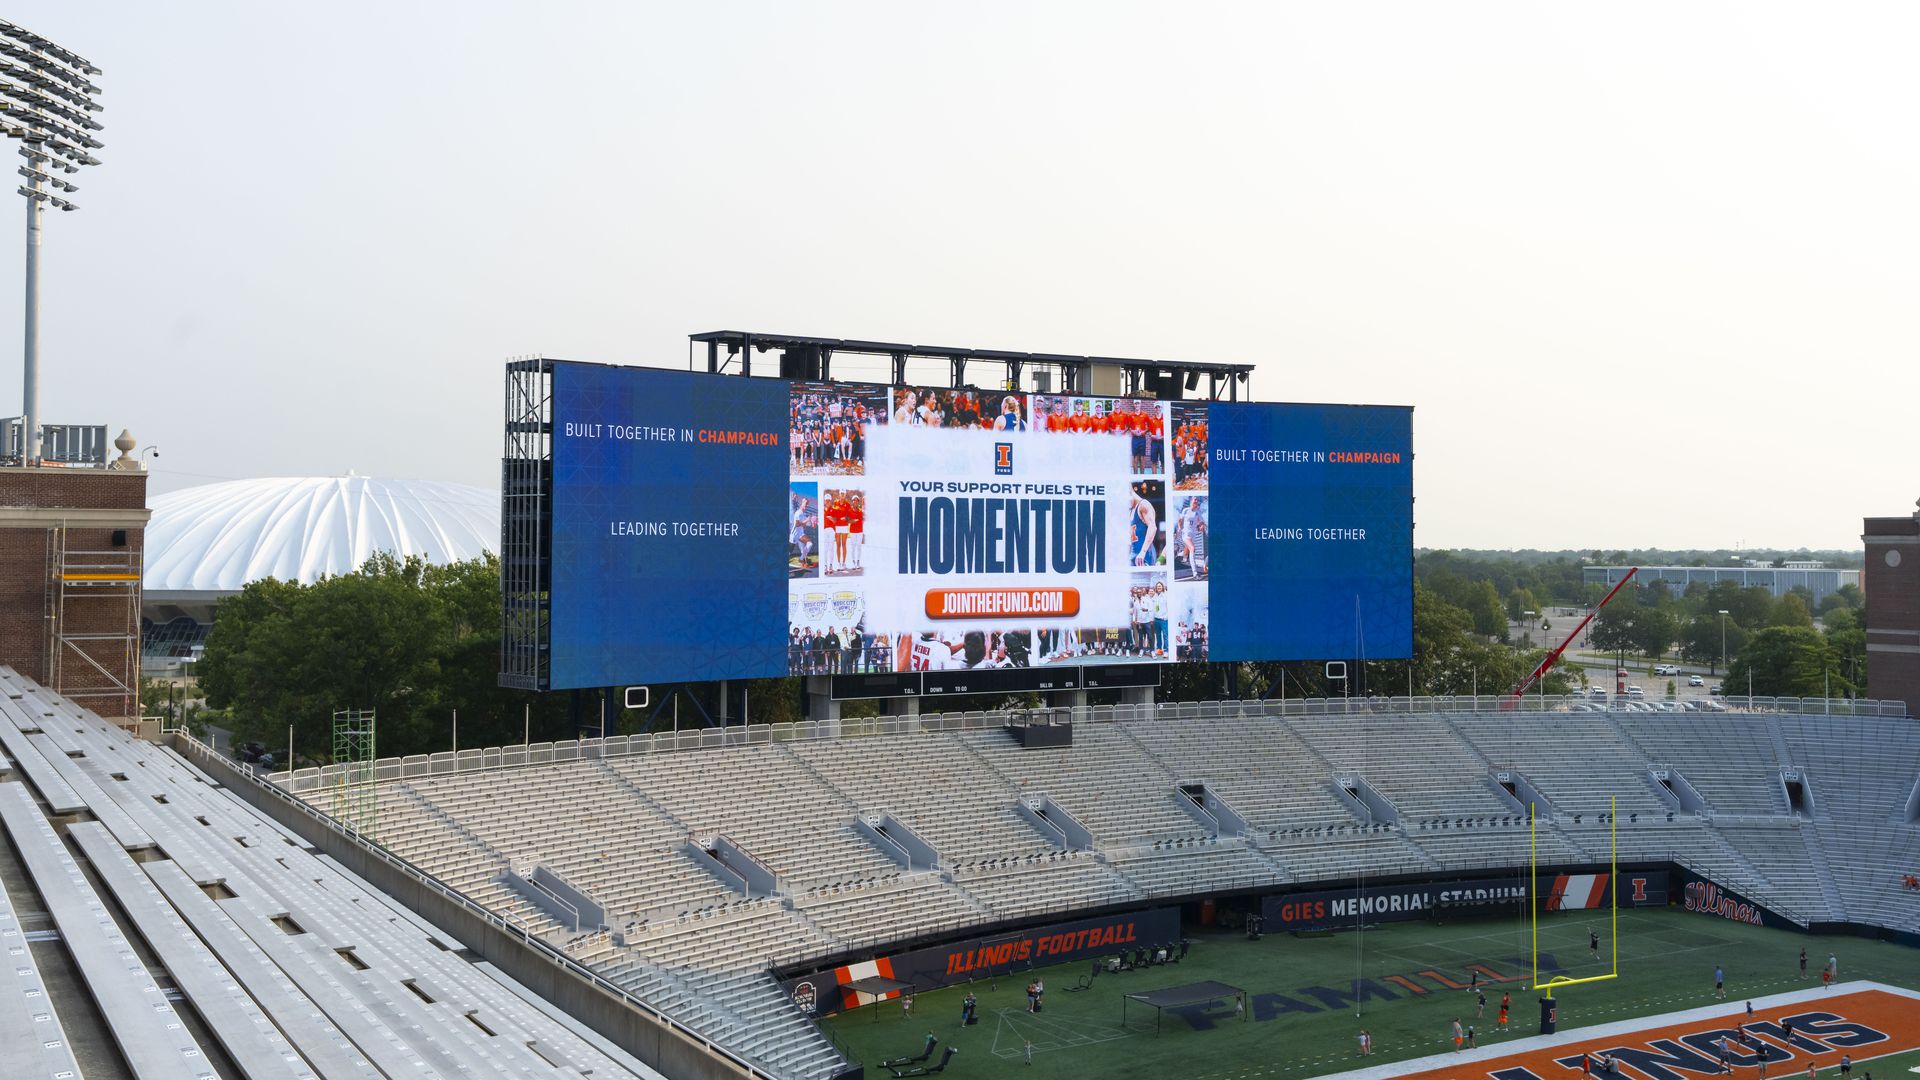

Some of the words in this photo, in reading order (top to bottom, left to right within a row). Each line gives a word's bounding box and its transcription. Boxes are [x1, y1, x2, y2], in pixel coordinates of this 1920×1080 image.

[566, 422, 602, 438] BUILT
[608, 425, 675, 442] TOGETHER
[681, 429, 694, 442] IN
[698, 429, 779, 446] CHAMPAIGN
[1216, 449, 1247, 461] BUILT
[1251, 450, 1309, 462] TOGETHER
[1314, 451, 1325, 463] IN
[1329, 452, 1400, 464] CHAMPAIGN
[900, 481, 944, 492] YOUR
[947, 482, 1021, 494] SUPPORT
[1025, 484, 1072, 495] FUELS
[1076, 485, 1105, 496] THE
[611, 522, 667, 536] LEADING
[672, 522, 738, 536] TOGETHER
[899, 496, 1106, 574] MOMENTUM
[1255, 528, 1303, 540] LEADING
[1307, 528, 1366, 540] TOGETHER
[942, 592, 1063, 614] JOINTHEIFUND.COM
[1632, 878, 1647, 900] I
[1281, 901, 1325, 922] GIES
[1331, 893, 1432, 917] MEMORIAL
[1440, 887, 1525, 908] STADIUM
[946, 940, 1033, 975] ILLINOIS
[1036, 923, 1136, 957] FOOTBALL
